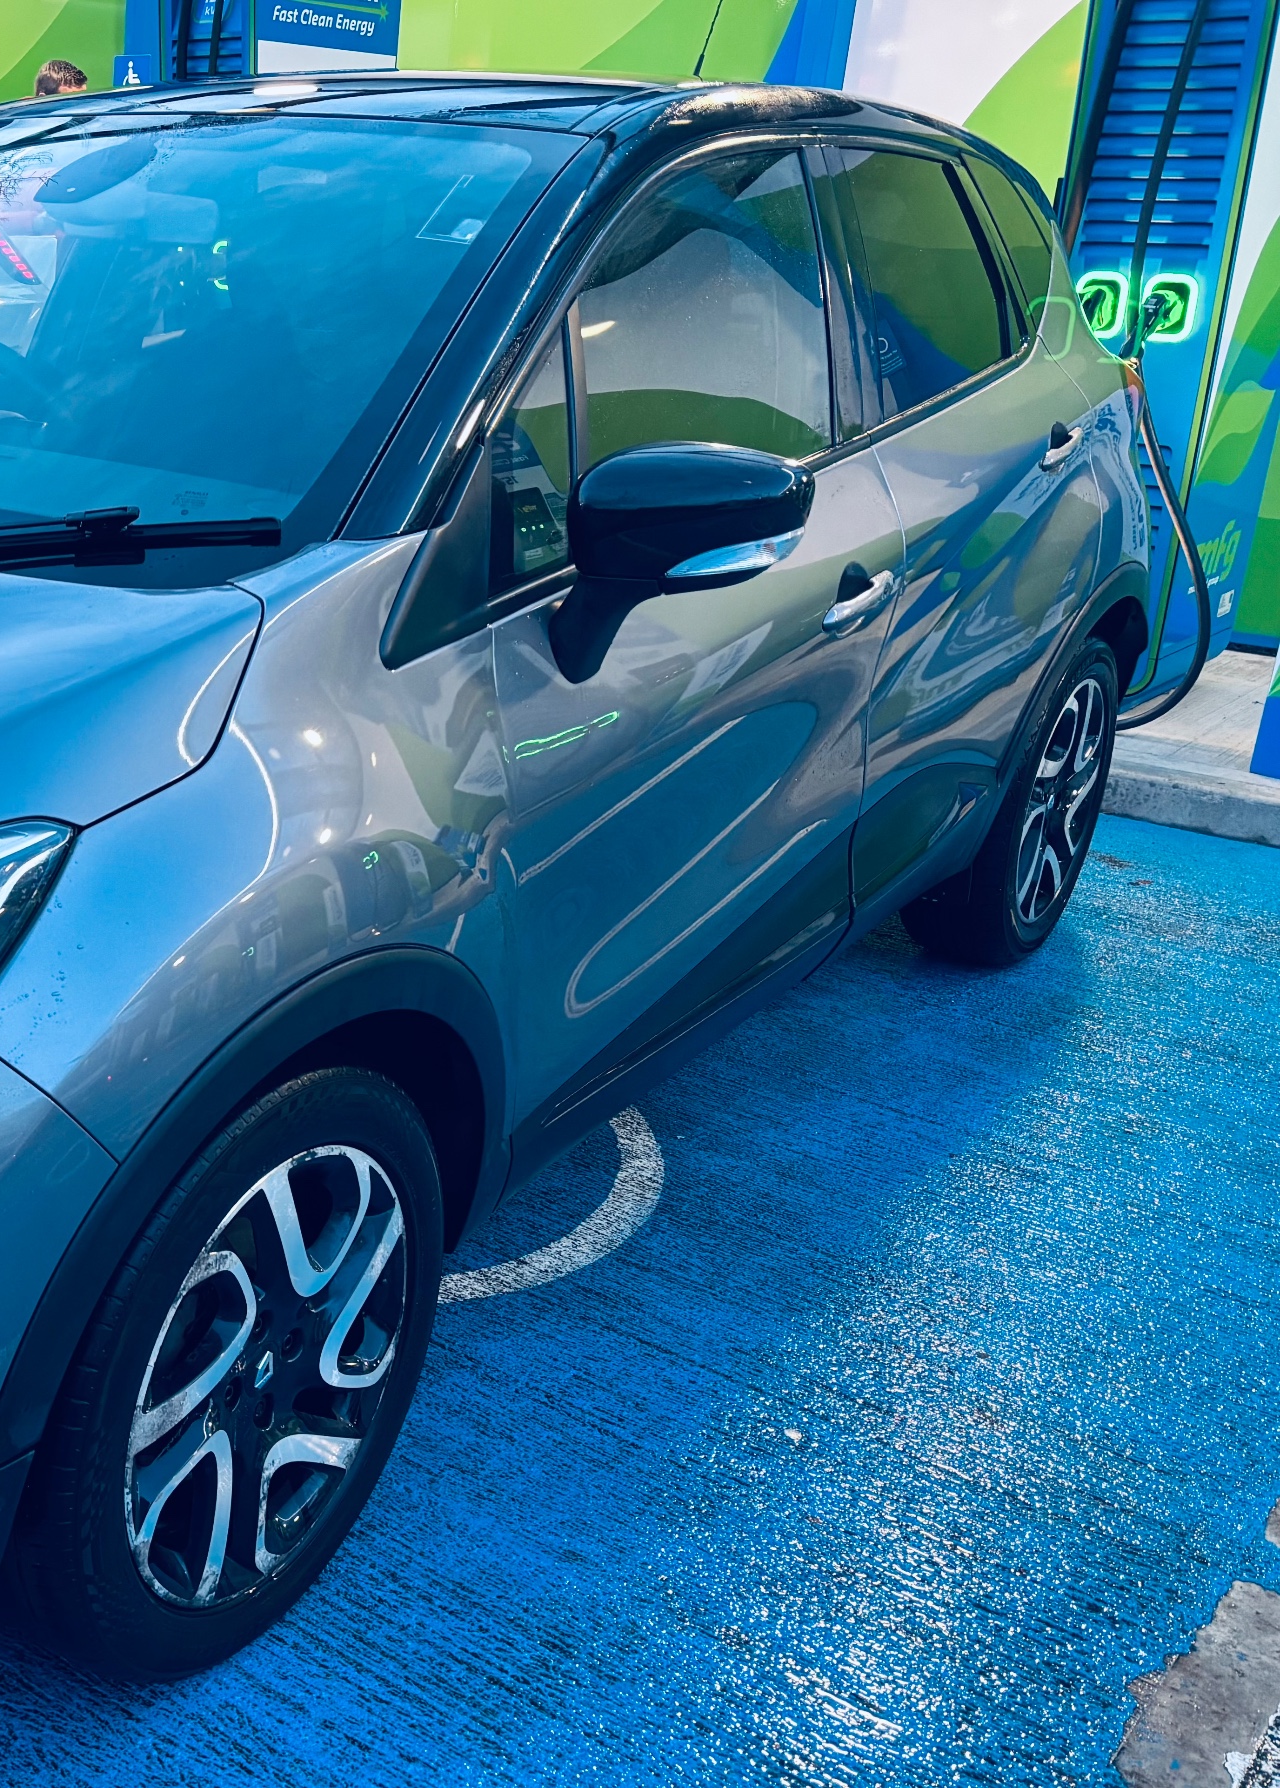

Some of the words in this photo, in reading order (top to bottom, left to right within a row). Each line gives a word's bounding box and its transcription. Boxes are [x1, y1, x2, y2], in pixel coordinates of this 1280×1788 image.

[272, 5, 299, 24] Fast
[300, 9, 334, 28] Clean
[335, 14, 376, 37] Energy
[1196, 519, 1242, 582] mfg
